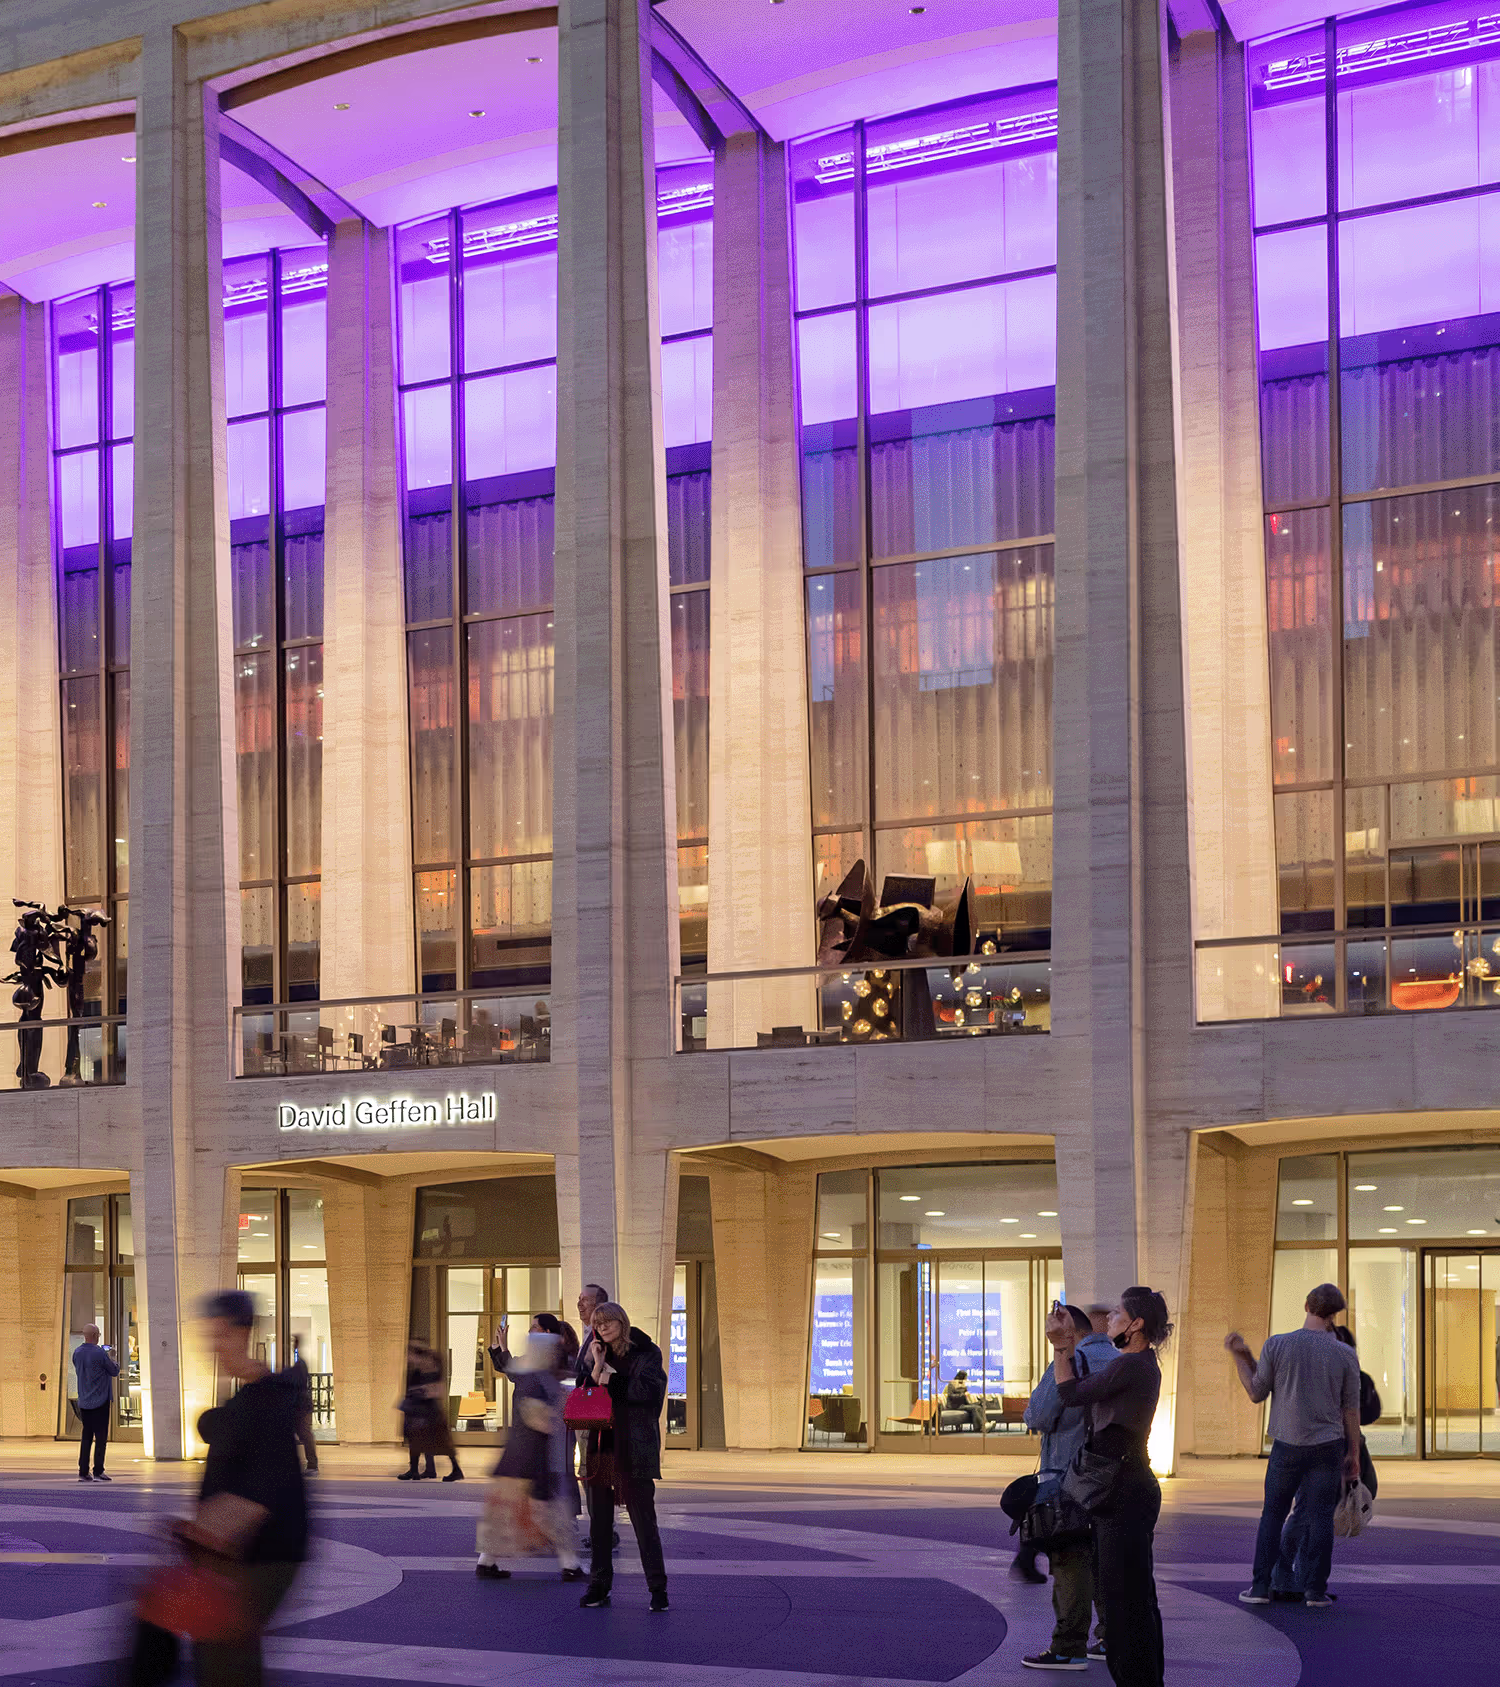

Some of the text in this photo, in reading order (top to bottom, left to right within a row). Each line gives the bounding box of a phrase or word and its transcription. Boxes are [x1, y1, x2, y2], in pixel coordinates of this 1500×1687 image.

[278, 1095, 494, 1128] David Geffen Hall
